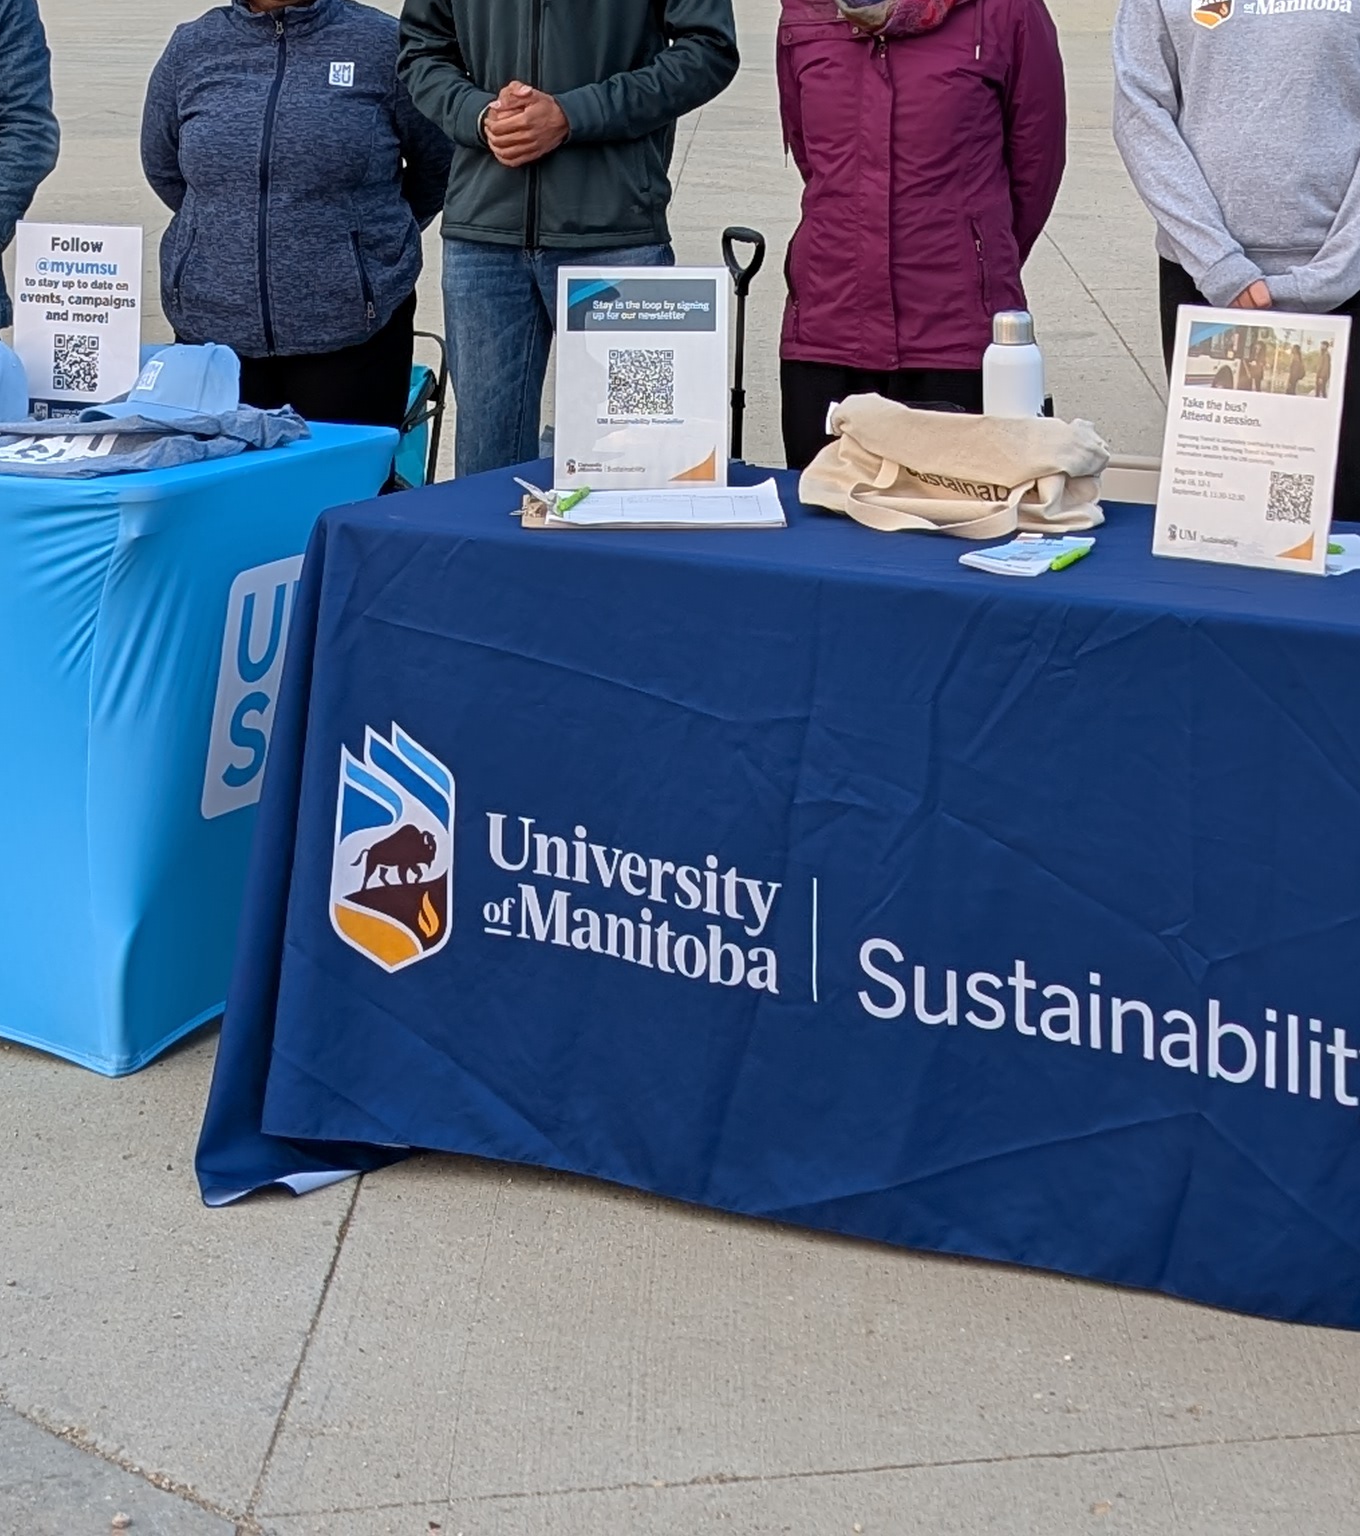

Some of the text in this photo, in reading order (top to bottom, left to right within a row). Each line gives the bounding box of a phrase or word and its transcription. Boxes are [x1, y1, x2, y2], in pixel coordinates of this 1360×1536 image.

[51, 237, 103, 253] Follow
[36, 257, 118, 275] @myumsu
[25, 277, 129, 291] to stay up to date on
[20, 292, 136, 309] events, campaigns
[593, 300, 613, 312] Stay
[625, 301, 640, 309] the
[642, 301, 661, 311] loop
[664, 301, 674, 310] by
[677, 300, 709, 311] signing
[45, 310, 109, 323] and more!
[593, 313, 604, 321] up
[638, 311, 686, 320] newsletter
[1182, 396, 1247, 413] Take the bus?
[1180, 410, 1262, 427] Attend a session.
[237, 580, 299, 683] U
[222, 691, 270, 788] S
[486, 812, 782, 937] University
[483, 883, 779, 995] of Manitoba
